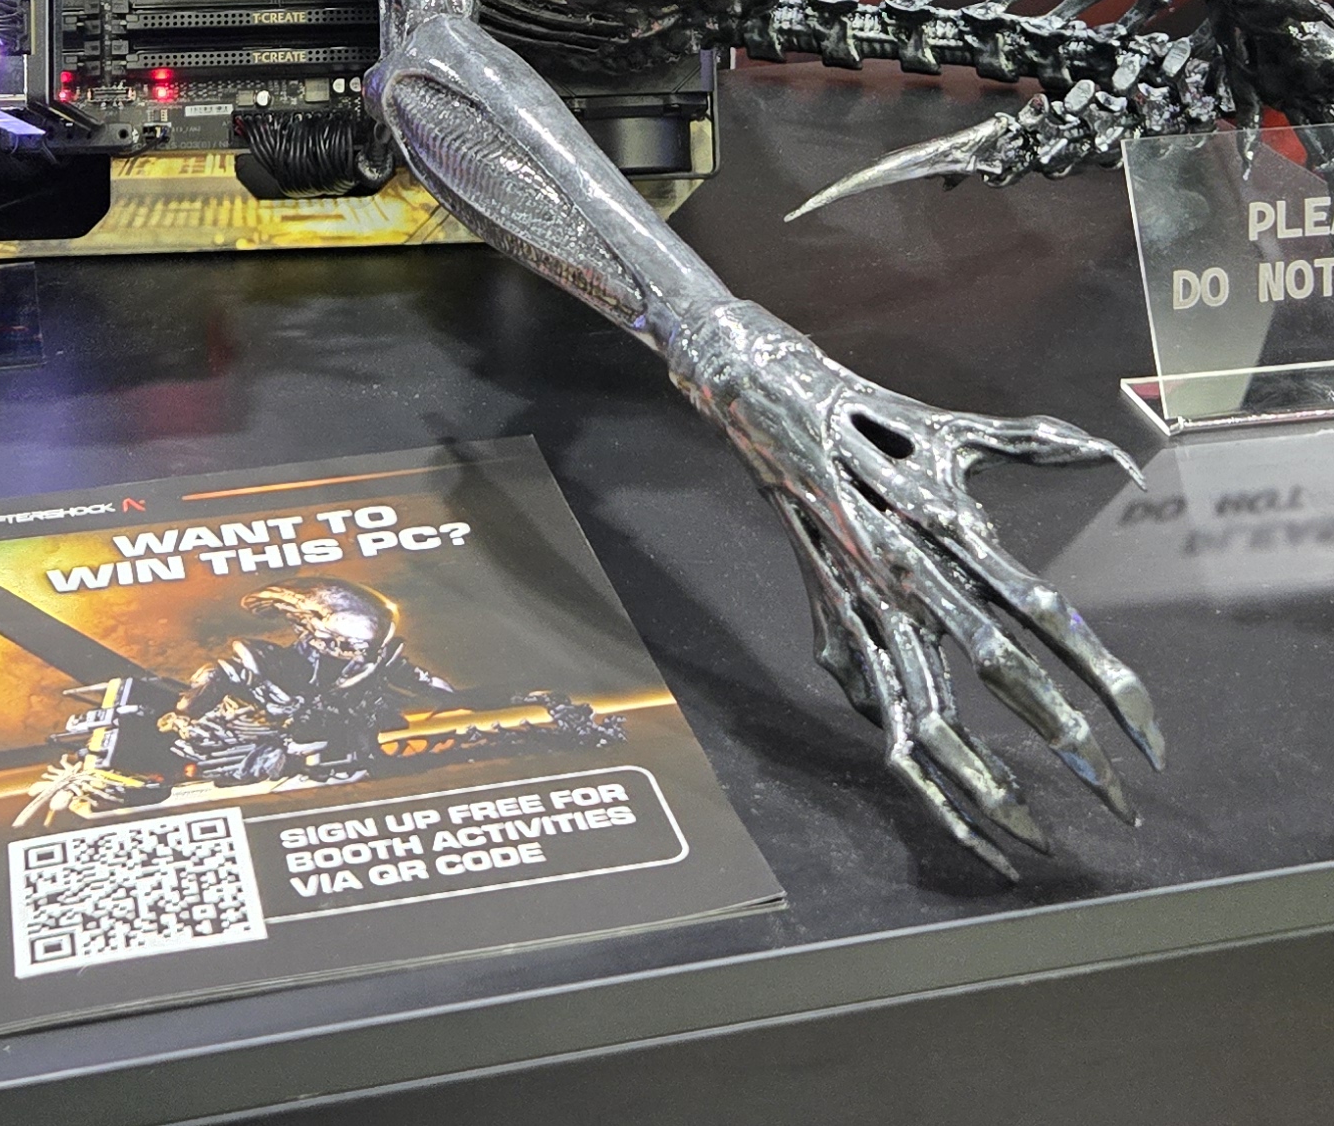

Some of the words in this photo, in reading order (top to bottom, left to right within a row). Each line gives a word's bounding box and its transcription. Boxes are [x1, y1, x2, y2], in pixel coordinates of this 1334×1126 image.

[1171, 266, 1230, 311] DO
[46, 556, 186, 594] WIN
[198, 538, 344, 577] THIS
[357, 520, 472, 557] PC?
[112, 515, 305, 557] WANT
[315, 503, 398, 534] TO
[280, 817, 380, 849] SIGN
[385, 809, 441, 833] UP
[448, 795, 544, 824] FREE
[550, 783, 629, 810] FOR
[285, 836, 425, 873] BOOTH
[431, 805, 638, 851] ACTIVITIES
[289, 869, 363, 898] VIA
[369, 859, 431, 887] QR
[437, 843, 546, 876] CODE
